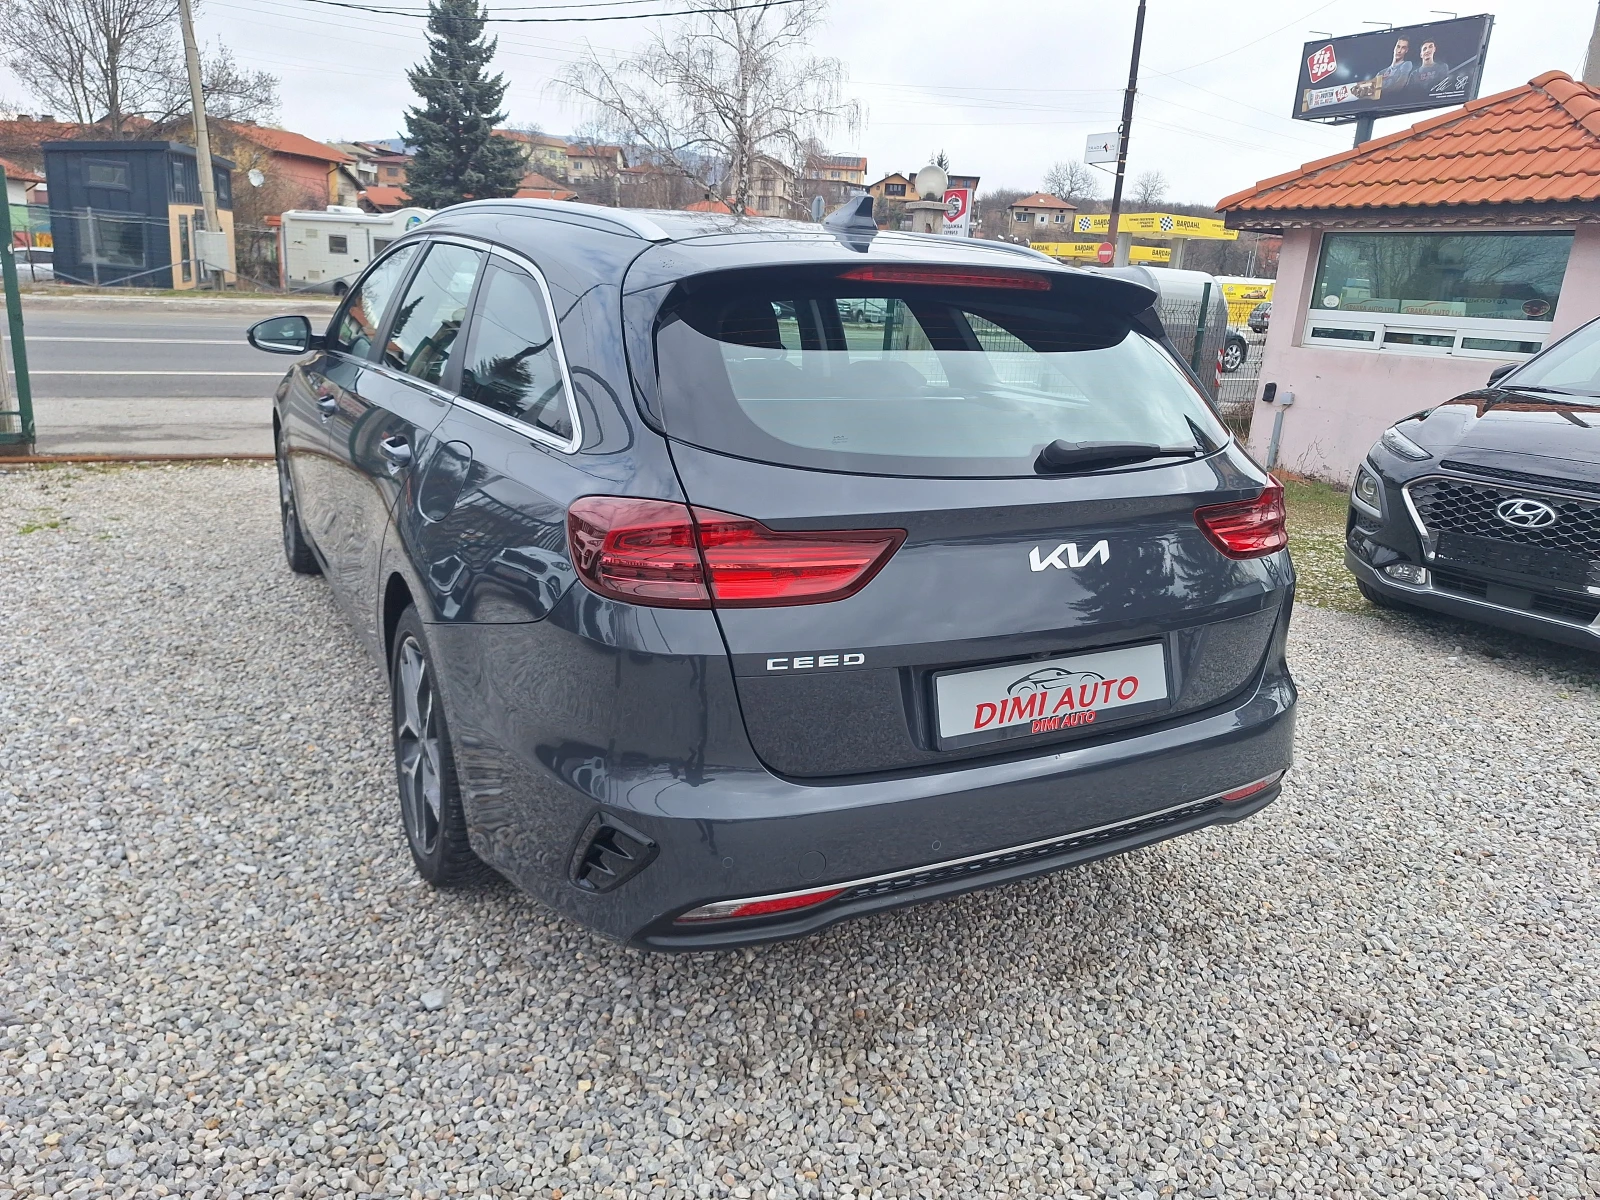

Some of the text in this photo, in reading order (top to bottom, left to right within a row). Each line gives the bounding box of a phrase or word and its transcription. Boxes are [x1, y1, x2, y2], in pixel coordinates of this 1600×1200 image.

[1312, 50, 1331, 65] fit
[1310, 61, 1335, 77] spo
[1093, 219, 1110, 228] BARDA
[1176, 220, 1201, 231] BARDAHL
[1074, 245, 1095, 253] BARDAHL
[1151, 249, 1171, 258] BARDAH
[1406, 307, 1431, 315] KRAKRA
[1028, 540, 1110, 572] KIA
[766, 653, 865, 671] CEED
[974, 675, 1139, 729] DIMI AUTO
[1031, 710, 1096, 734] DIMI AUTO
